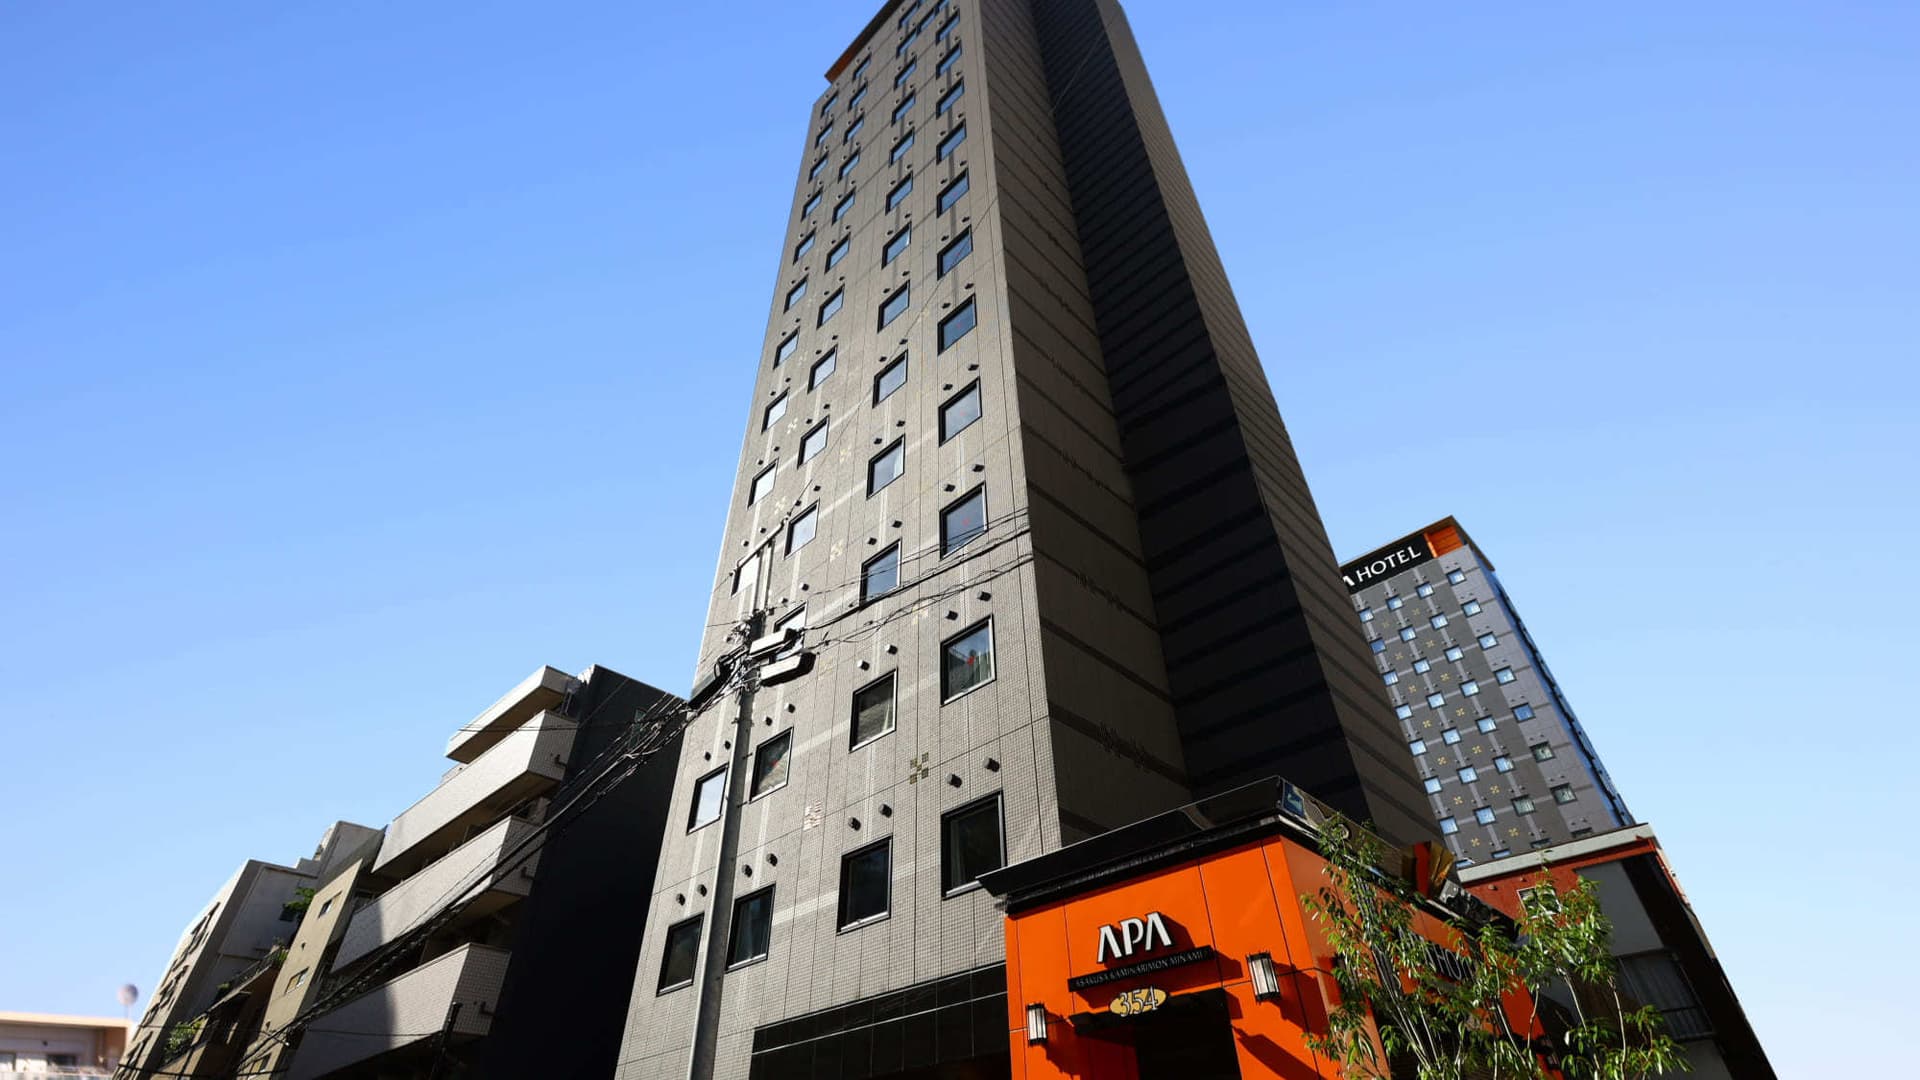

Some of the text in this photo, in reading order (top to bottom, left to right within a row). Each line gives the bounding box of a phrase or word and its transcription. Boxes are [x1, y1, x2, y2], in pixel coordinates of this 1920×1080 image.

[1355, 546, 1422, 582] HOTEL
[1097, 911, 1172, 962] APA
[1119, 985, 1158, 1017] 354
